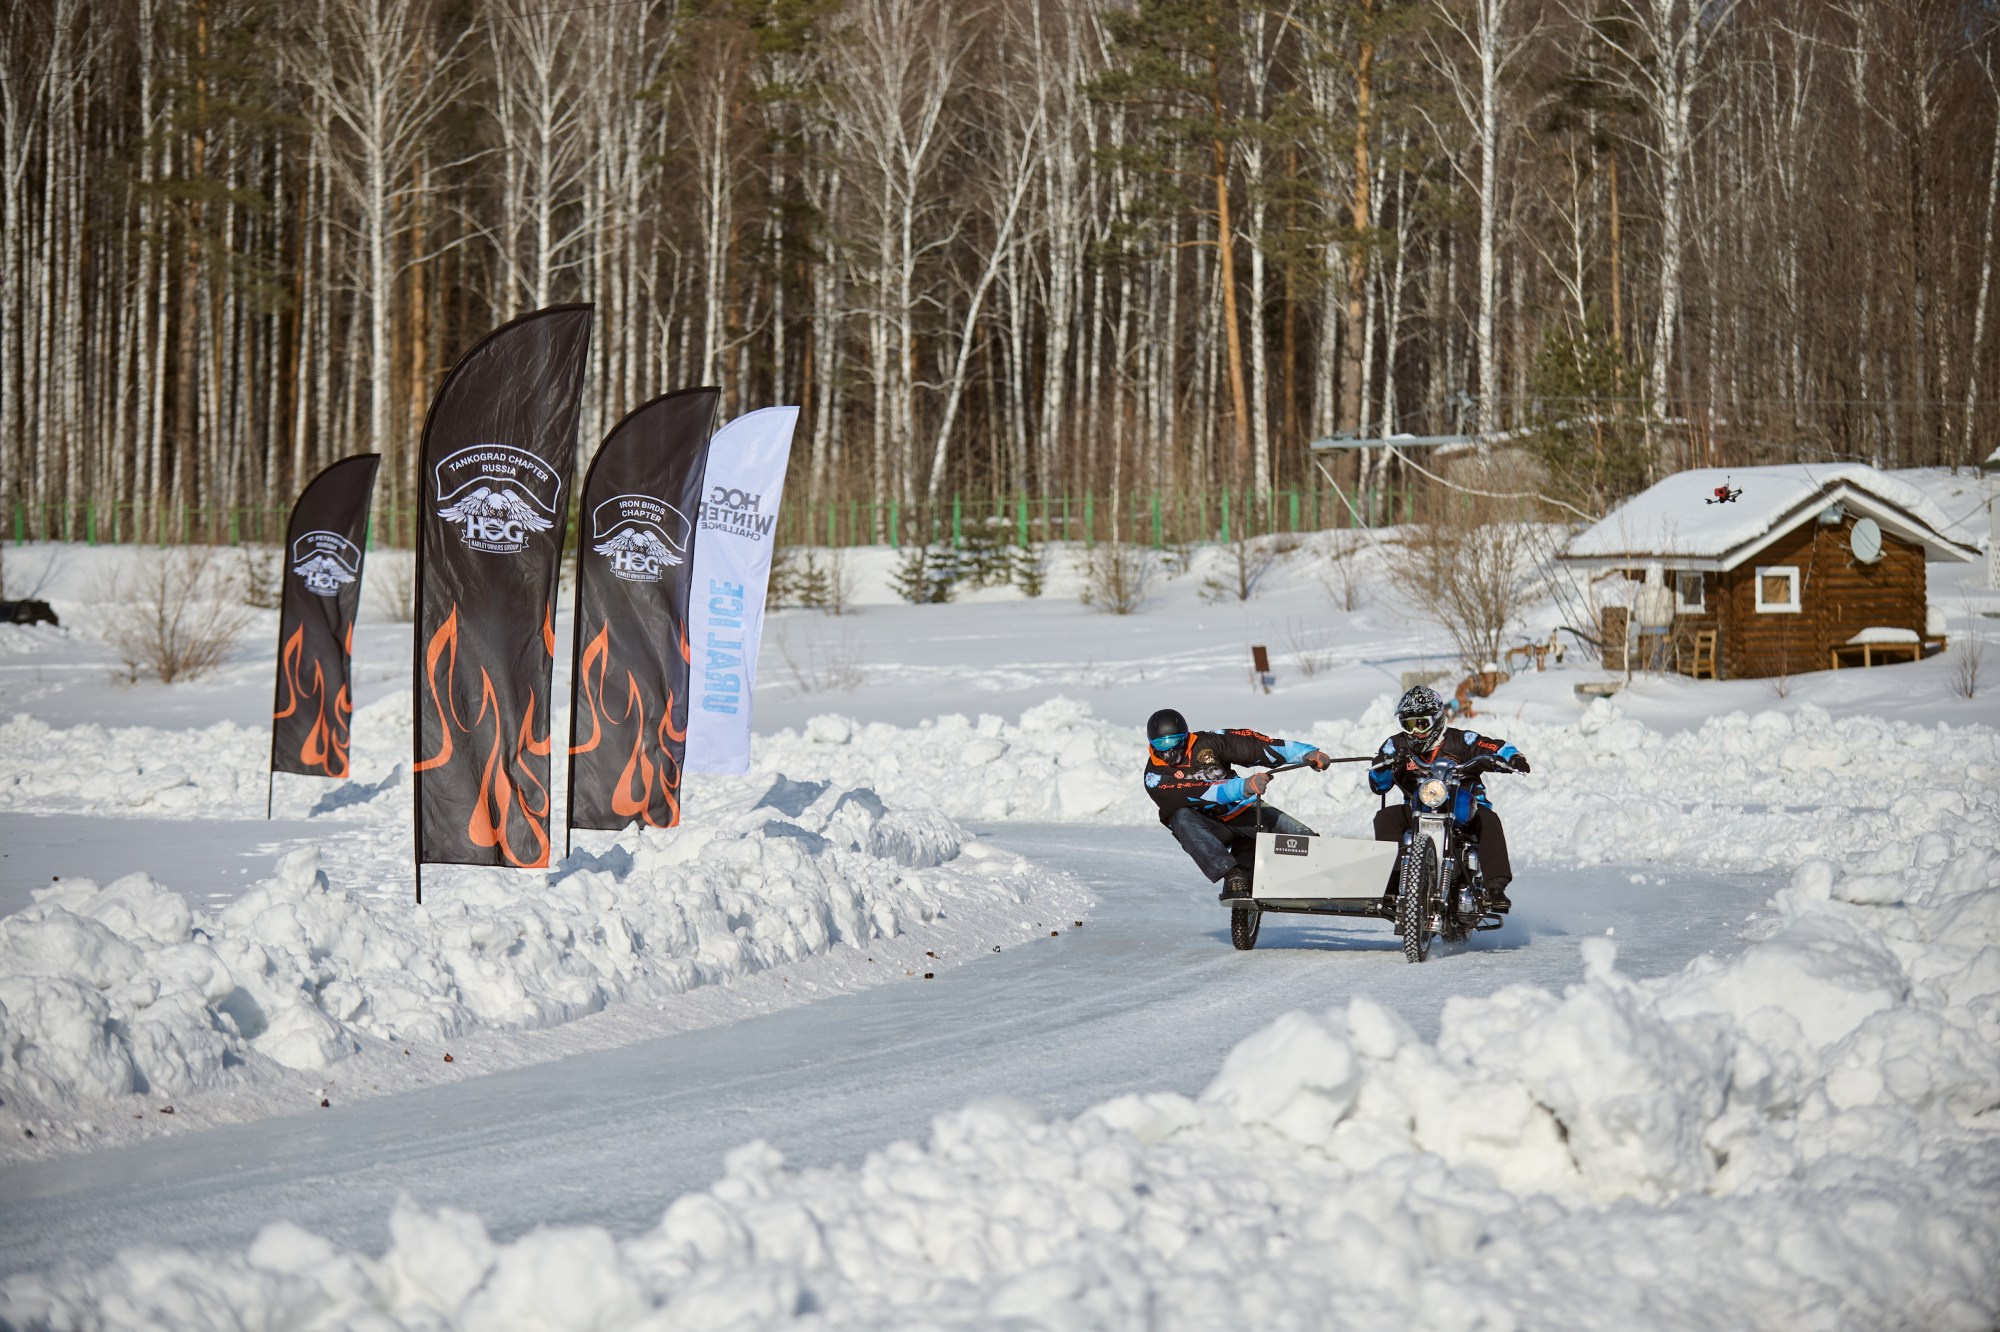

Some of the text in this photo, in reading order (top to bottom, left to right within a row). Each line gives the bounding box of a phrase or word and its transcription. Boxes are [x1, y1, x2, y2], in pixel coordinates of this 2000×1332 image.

[448, 452, 549, 482] TANKOGRAD CHAPTER
[481, 464, 517, 476] RUSSIA
[619, 500, 666, 515] IRON BIRDS
[621, 510, 662, 523] CHAPTER
